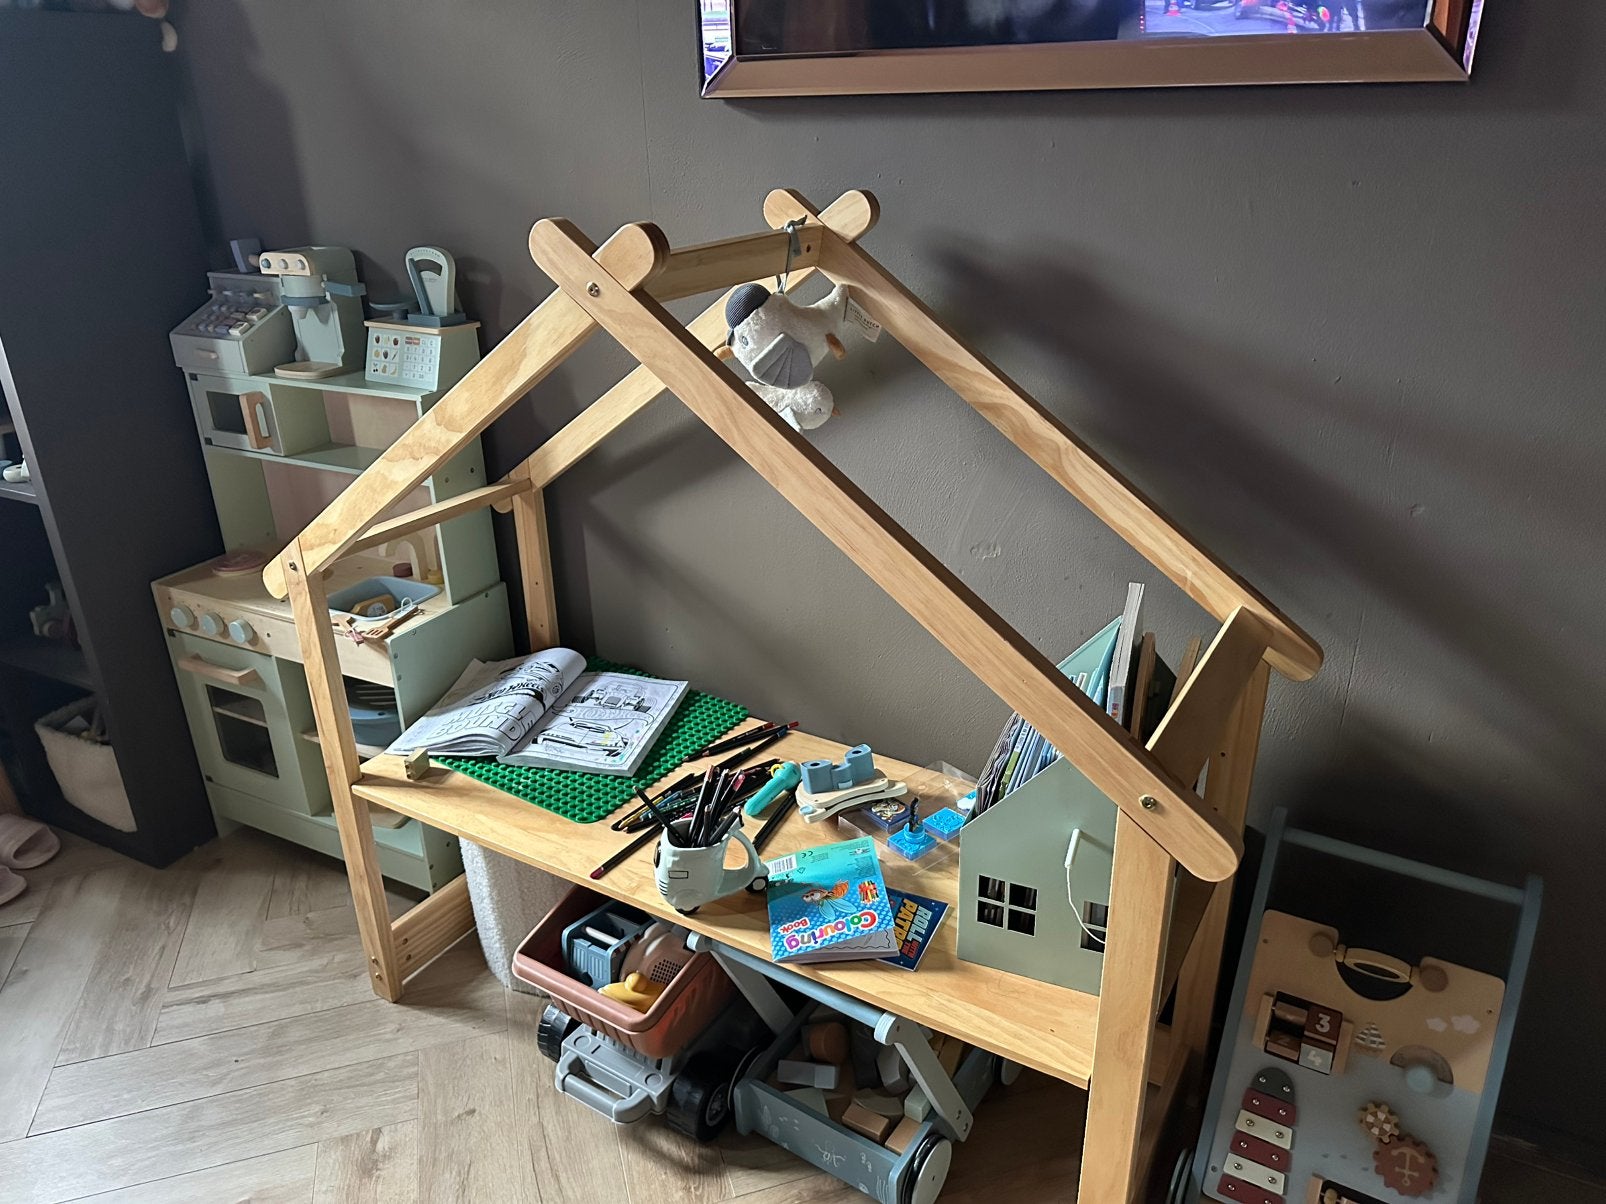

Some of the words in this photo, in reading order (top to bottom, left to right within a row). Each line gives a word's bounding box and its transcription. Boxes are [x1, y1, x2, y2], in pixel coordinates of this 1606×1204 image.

[780, 918, 809, 934] Book
[785, 910, 877, 950] Colouring
[906, 905, 933, 943] ROLL
[1315, 1012, 1331, 1033] 3
[1307, 1050, 1322, 1066] 4
